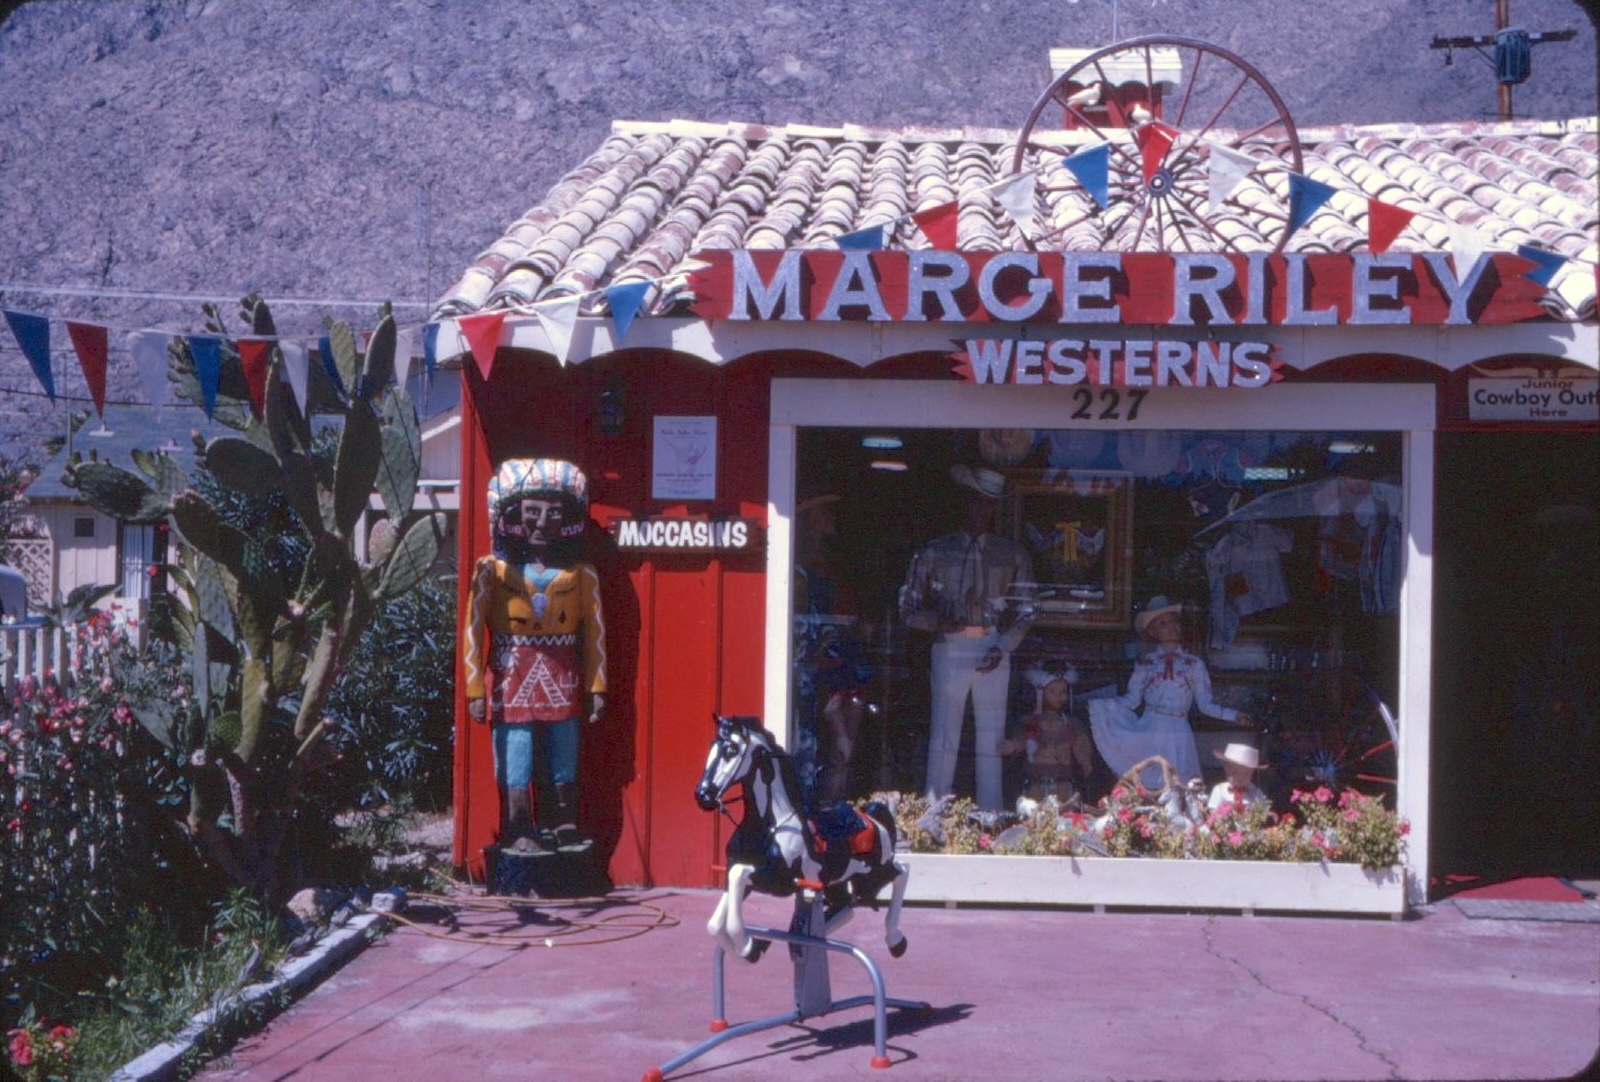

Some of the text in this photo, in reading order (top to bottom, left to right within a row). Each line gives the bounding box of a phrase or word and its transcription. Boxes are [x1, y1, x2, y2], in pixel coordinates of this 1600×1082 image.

[728, 250, 1493, 325] MARGE RILEY
[965, 338, 1272, 388] WESTERNS
[1474, 388, 1551, 408] Cowboy
[1522, 379, 1574, 390] Junior
[1070, 388, 1149, 421] 227
[1530, 408, 1568, 417] Here
[618, 520, 748, 547] MOCCASINS
